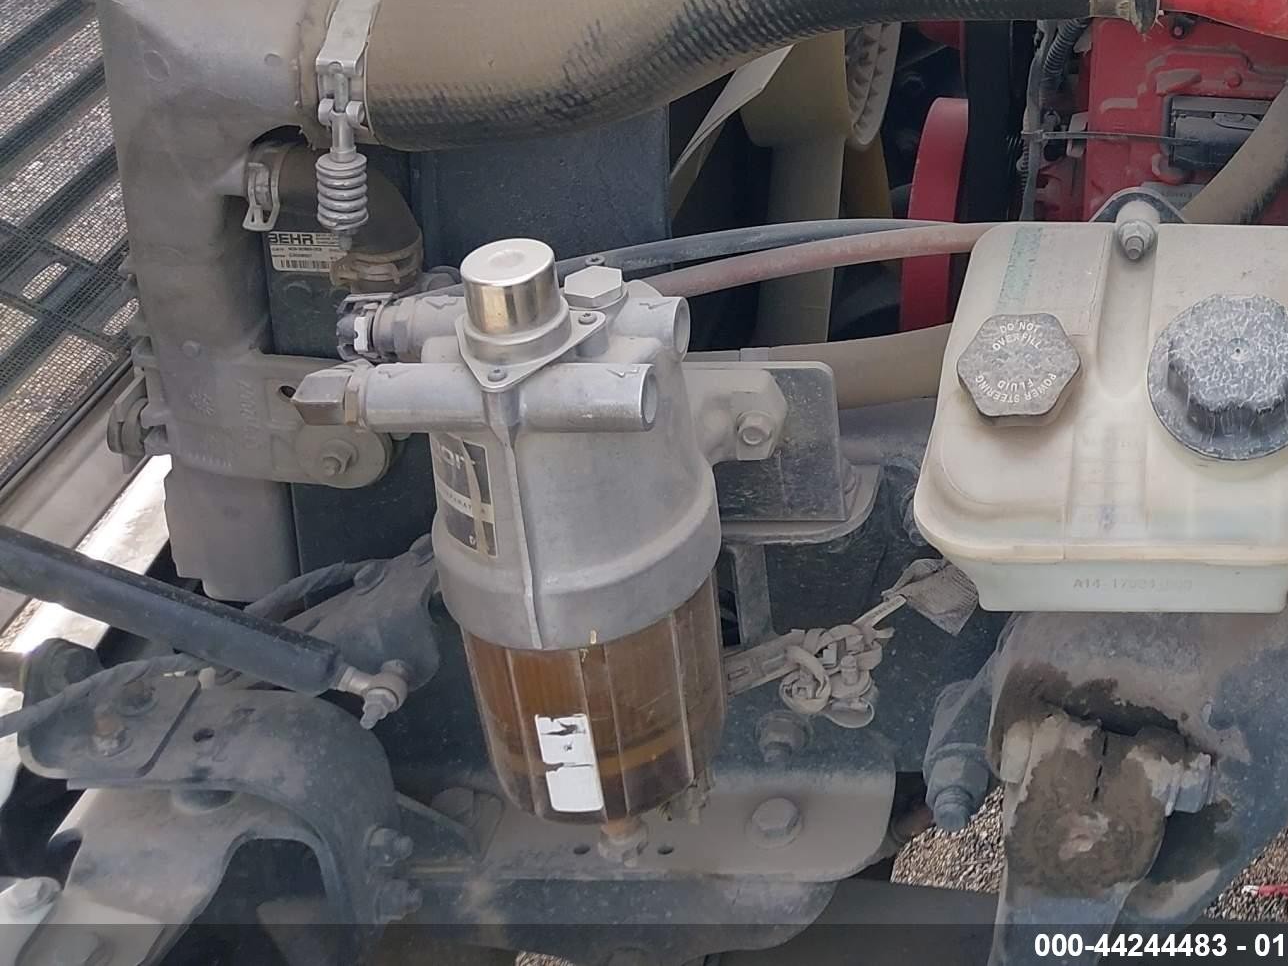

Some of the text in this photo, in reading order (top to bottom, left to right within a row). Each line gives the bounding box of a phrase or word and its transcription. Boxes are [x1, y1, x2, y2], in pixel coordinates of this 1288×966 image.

[267, 233, 315, 245] BEHR
[1000, 321, 1041, 333] DO NOT
[975, 373, 1057, 403] POWER STEERING
[997, 378, 1033, 392] FLUID
